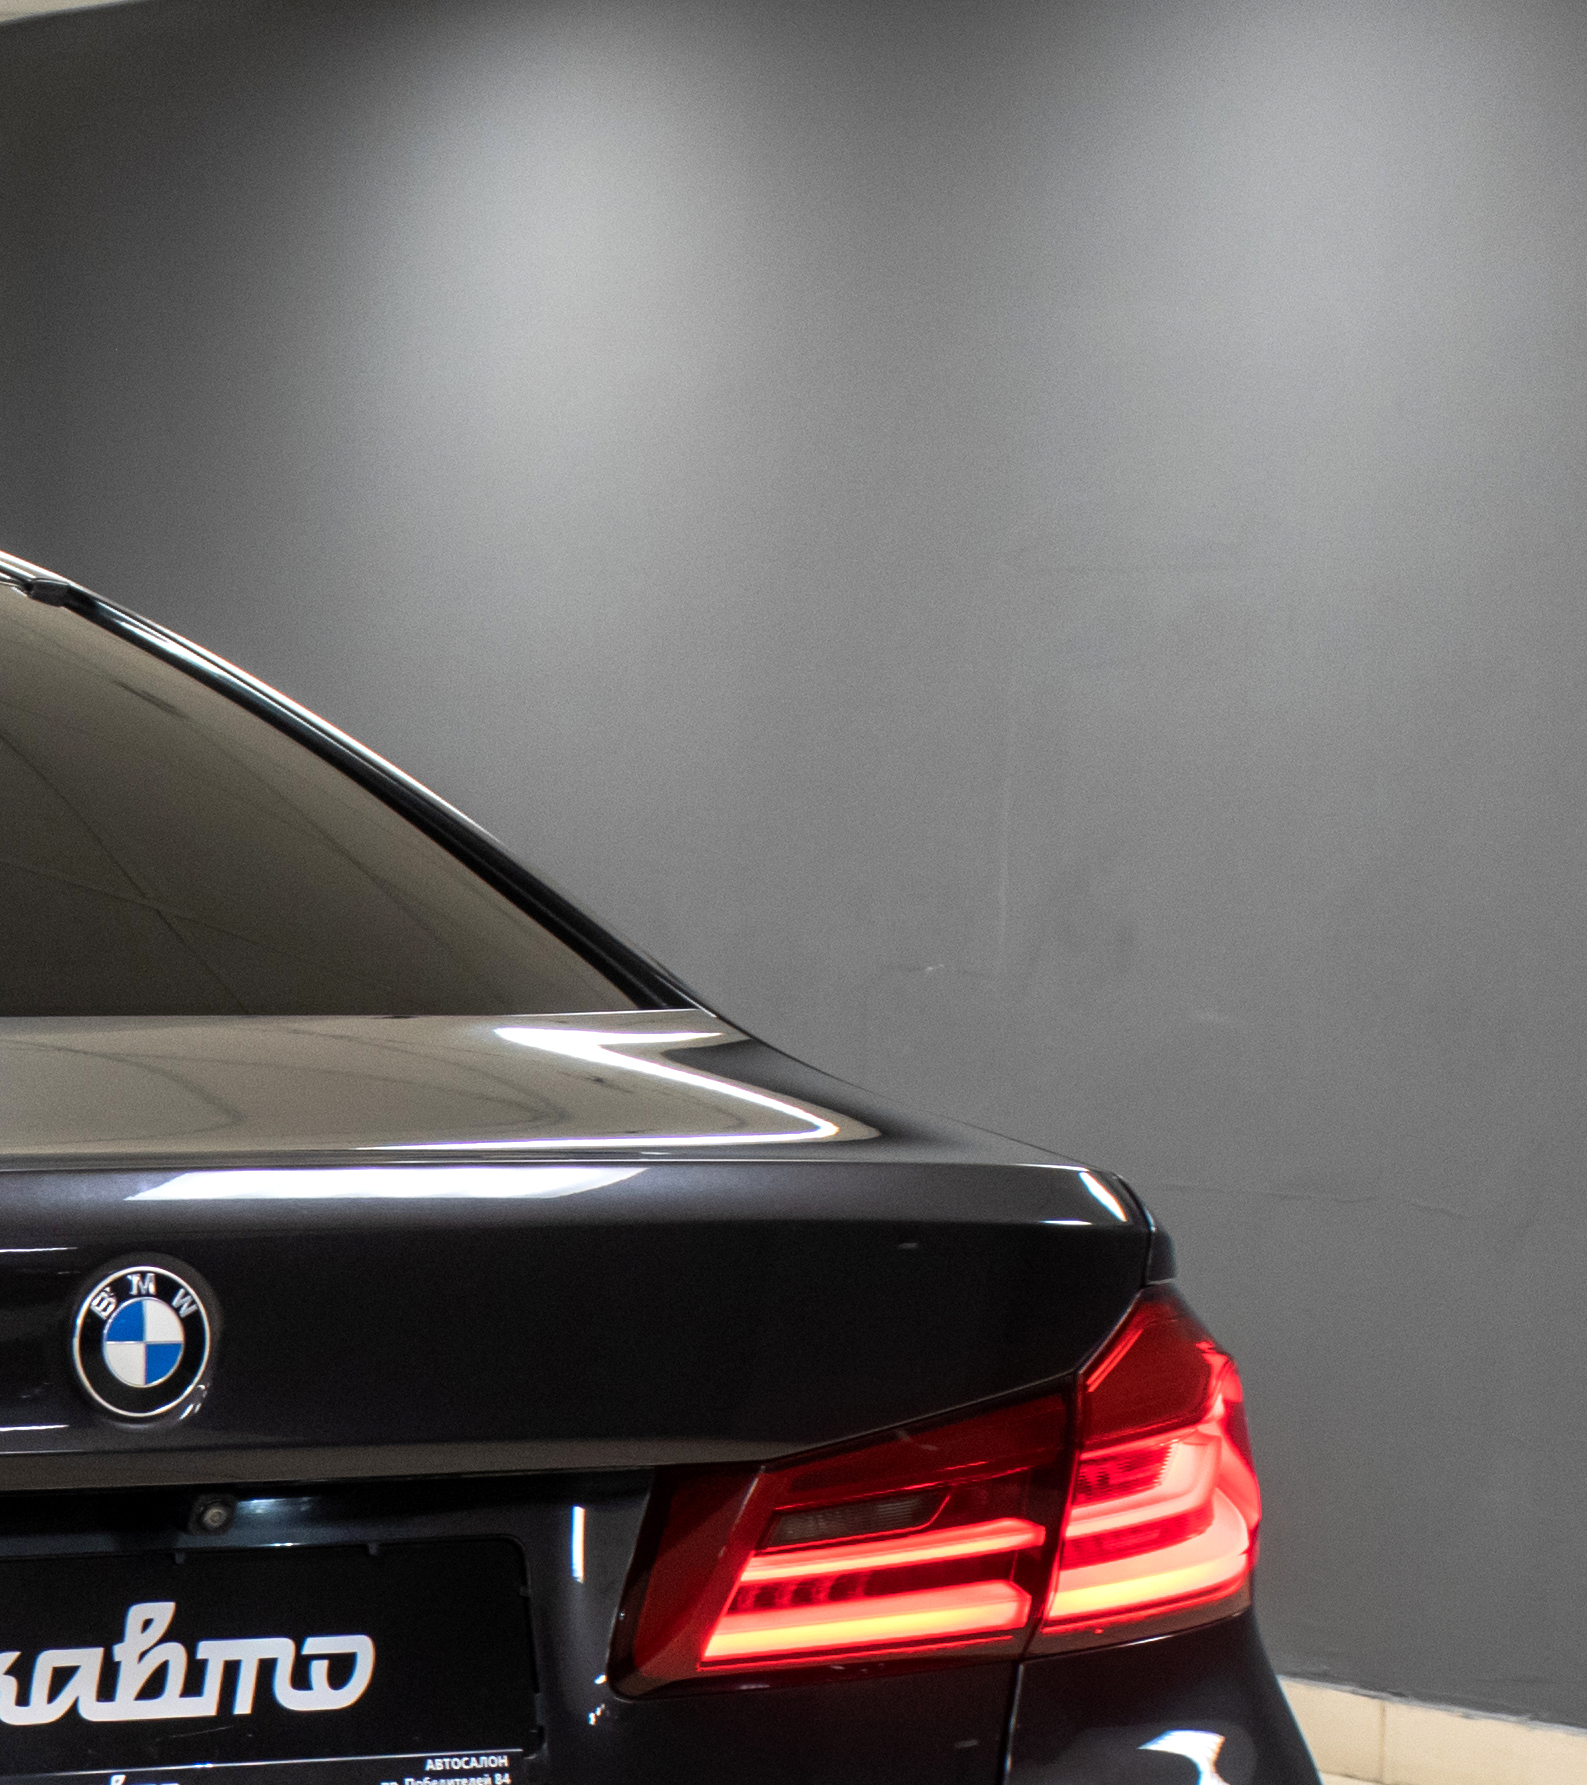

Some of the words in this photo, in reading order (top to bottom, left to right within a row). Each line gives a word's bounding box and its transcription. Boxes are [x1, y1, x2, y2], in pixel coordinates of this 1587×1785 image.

[89, 1272, 200, 1320] BMW
[425, 1754, 510, 1771] АВТОСАЛОН
[494, 1772, 512, 1785] 84
